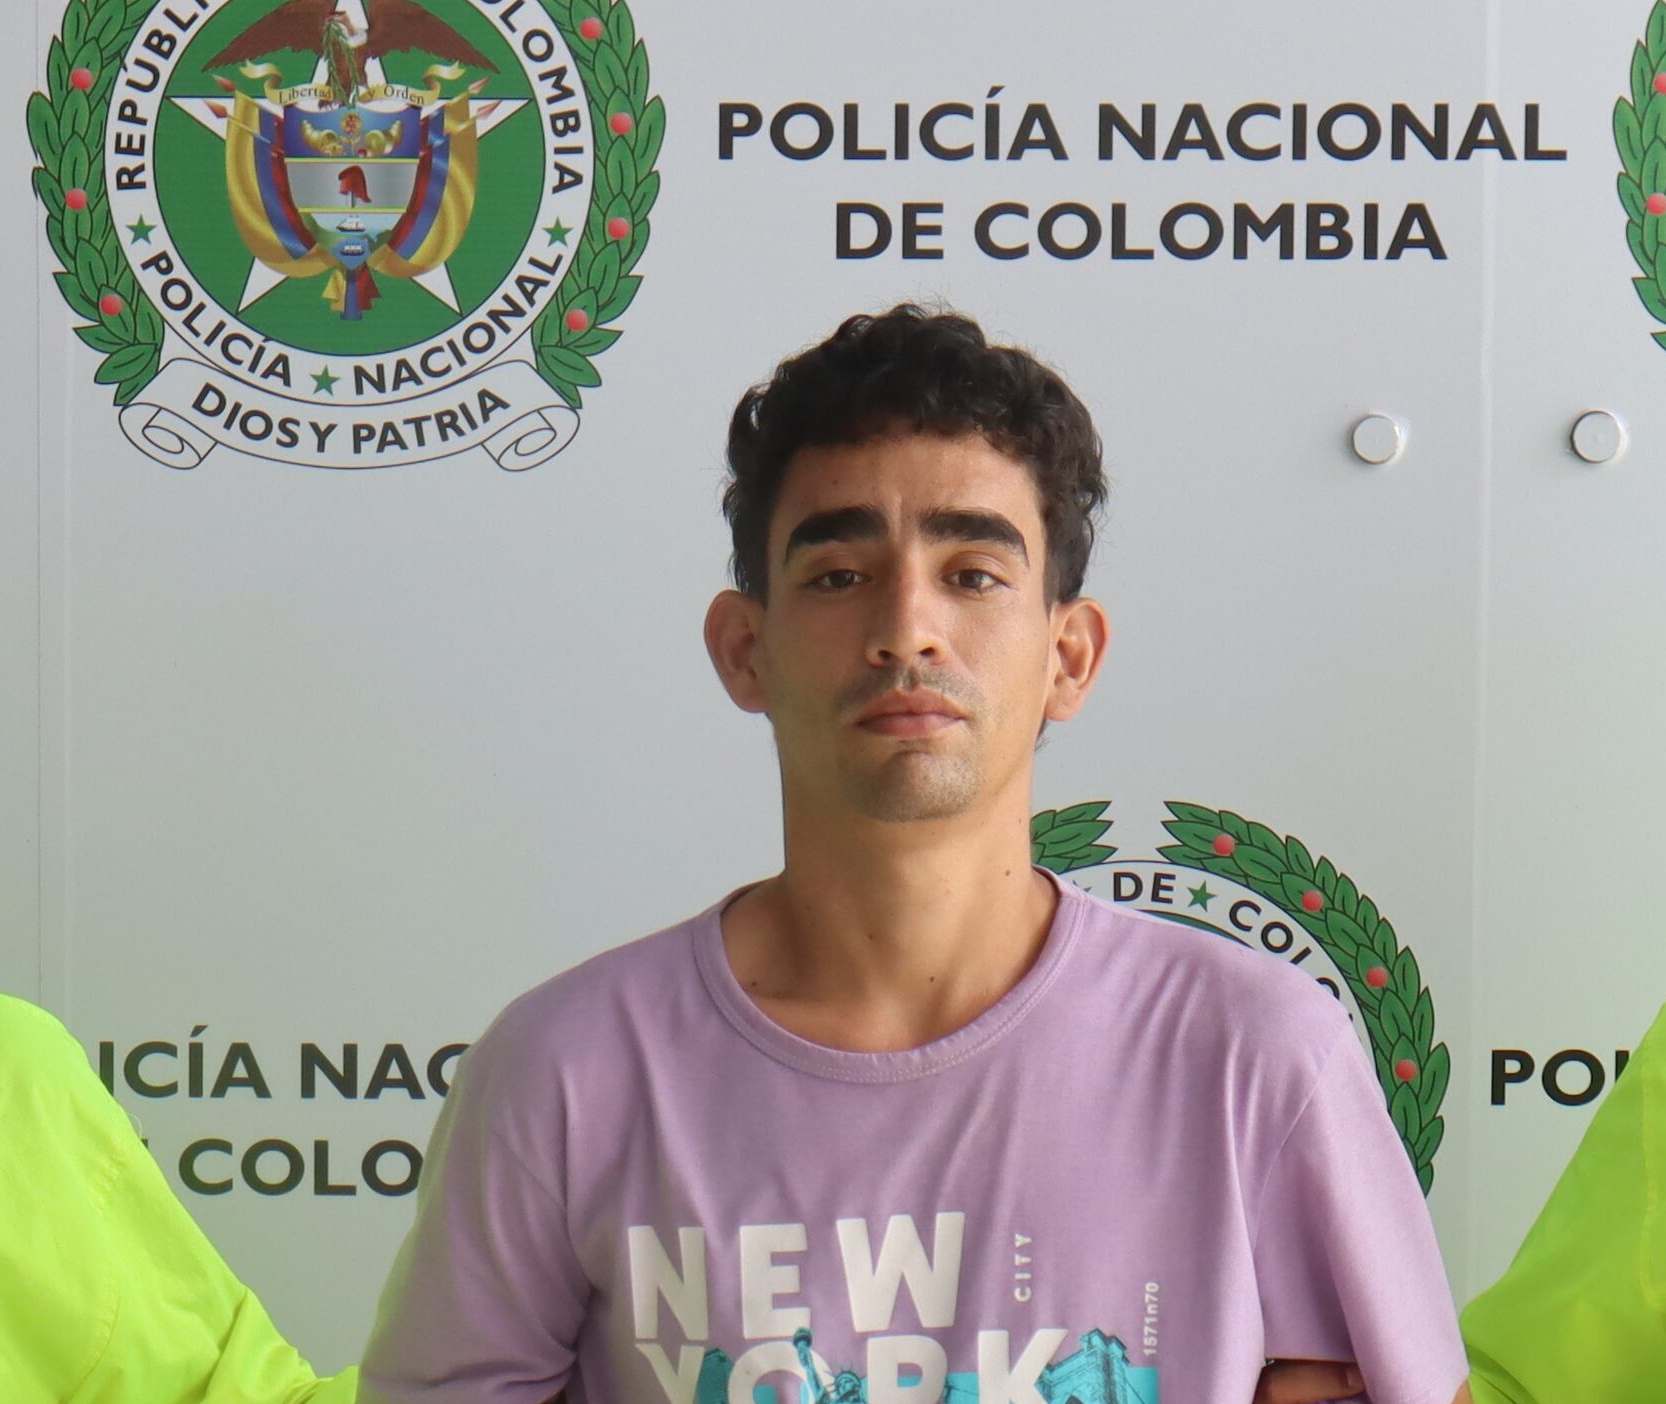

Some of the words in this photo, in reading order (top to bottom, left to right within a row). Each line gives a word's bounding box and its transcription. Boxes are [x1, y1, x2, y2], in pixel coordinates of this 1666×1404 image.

[115, 0, 209, 190] REPÚBL
[486, 0, 583, 194] LOMBIA
[384, 86, 424, 104] Orden
[719, 86, 1068, 161] POLICÍA
[1099, 103, 1567, 161] NACIONAL
[836, 203, 943, 259] DE
[975, 203, 1447, 260] COLOMBIA
[140, 250, 292, 389] POLICÍA
[354, 251, 562, 396] NACIONAL
[353, 387, 511, 454] PATRIA
[1112, 872, 1177, 904] DE
[99, 1024, 272, 1099] ICÍA
[178, 1138, 424, 1197] COLO
[629, 1211, 966, 1341] NEW
[1014, 1233, 1032, 1302] CITY
